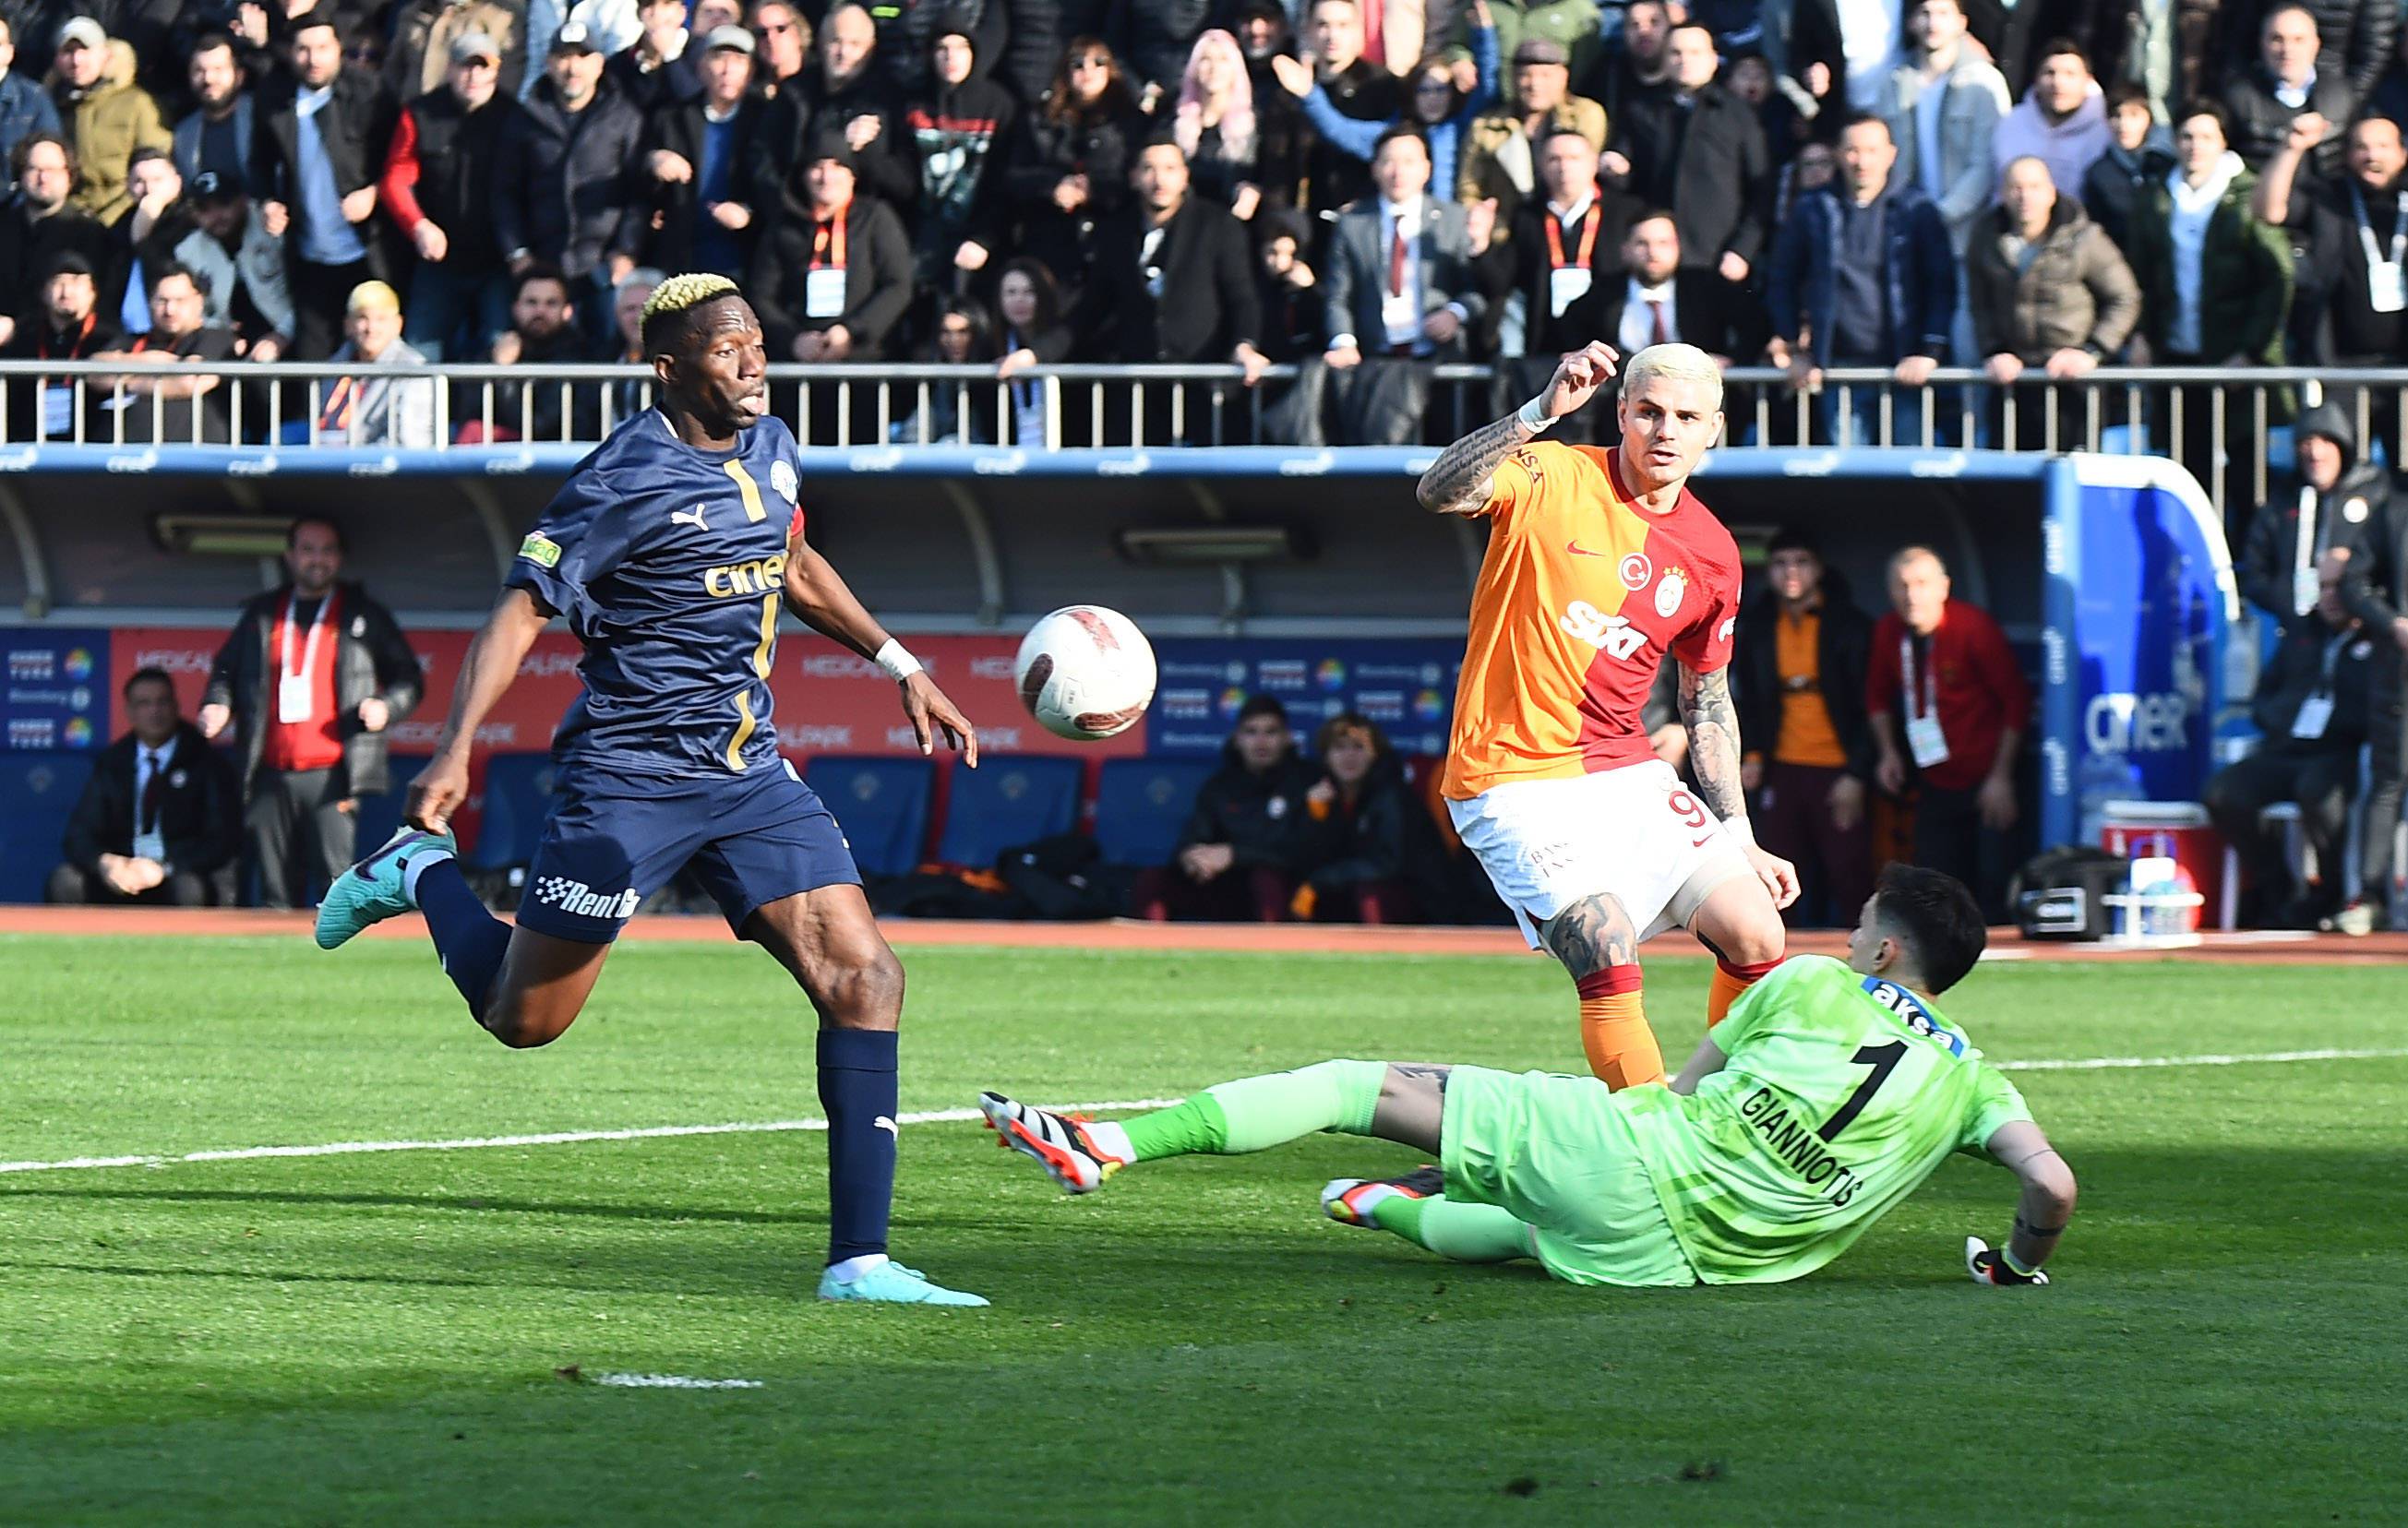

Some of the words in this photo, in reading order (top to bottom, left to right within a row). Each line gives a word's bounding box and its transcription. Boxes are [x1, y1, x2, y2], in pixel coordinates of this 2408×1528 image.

[704, 551, 789, 598] cine
[1669, 790, 1707, 828] 9
[1871, 982, 1954, 1050] aksa
[1816, 1039, 1909, 1143] 1
[1742, 1087, 1863, 1207] GIANNIOTIS
